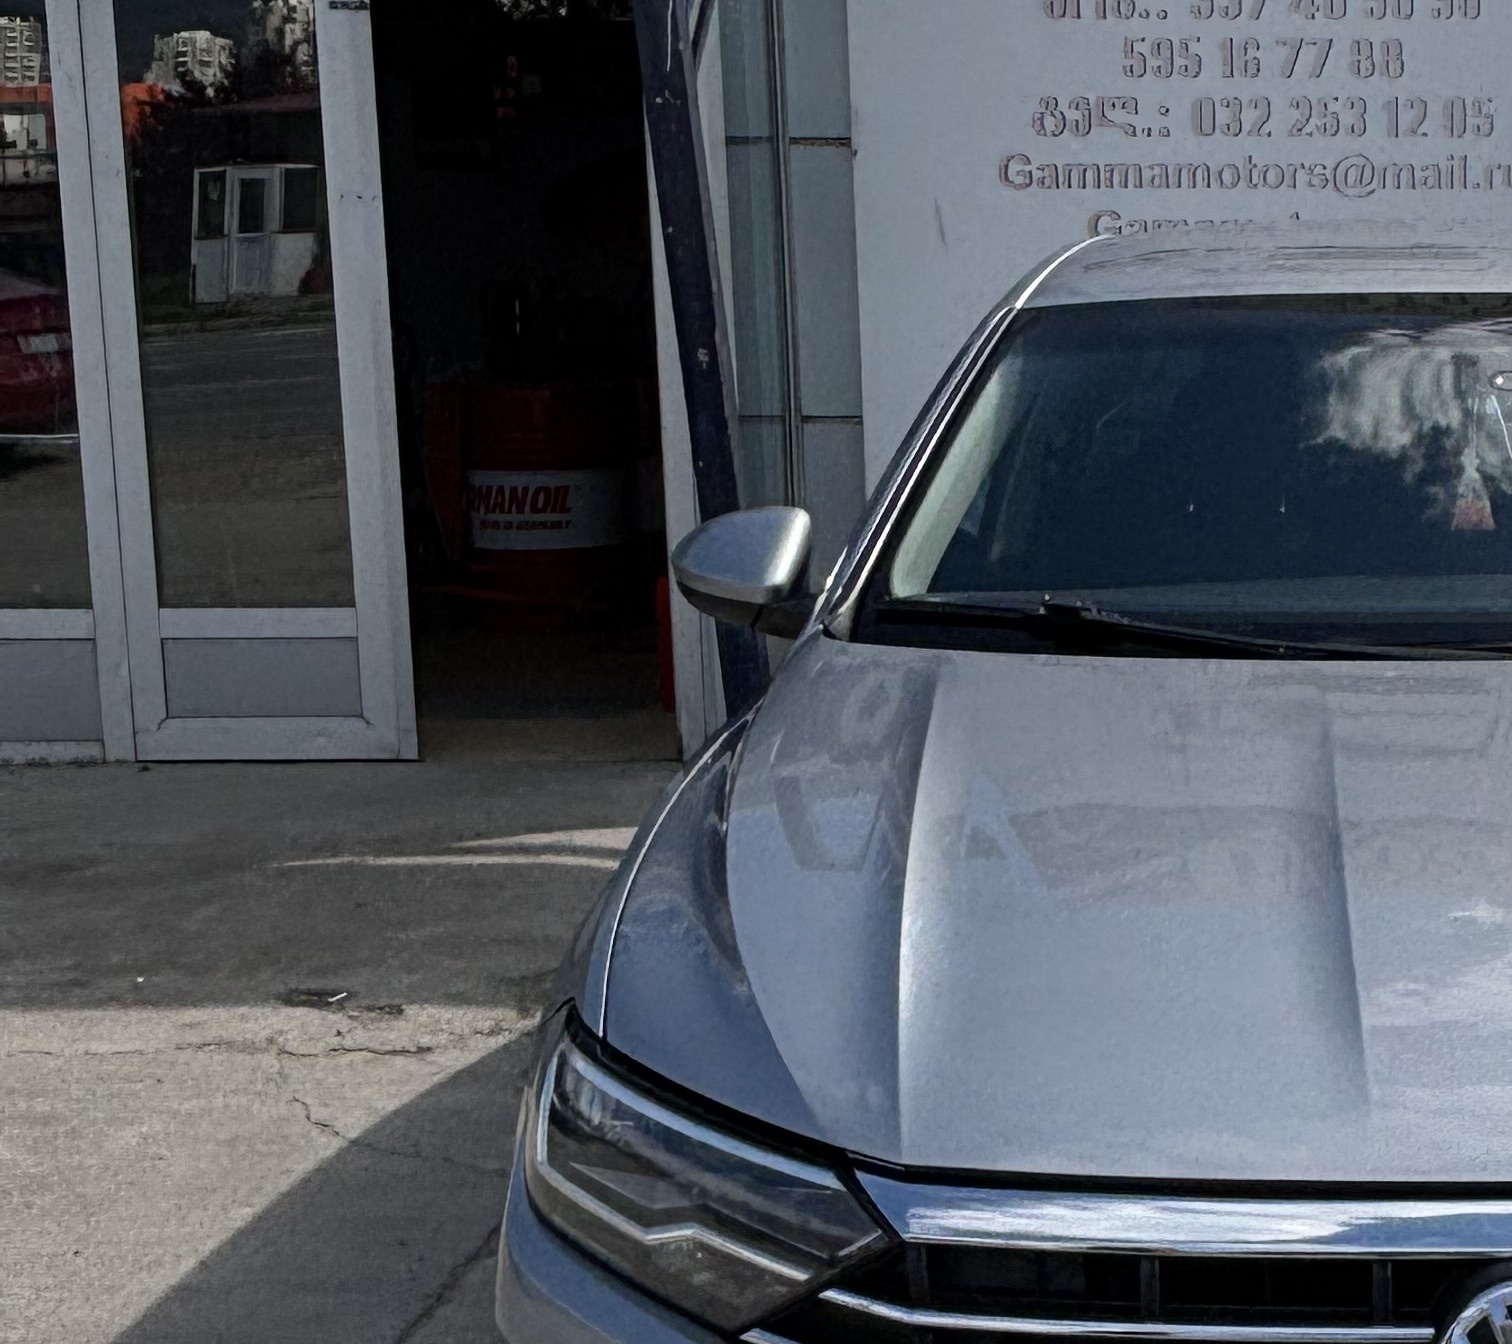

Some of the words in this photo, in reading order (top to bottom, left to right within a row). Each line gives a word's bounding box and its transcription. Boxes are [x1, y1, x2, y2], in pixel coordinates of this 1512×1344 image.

[1121, 35, 1203, 79] 595
[1274, 37, 1335, 80] 77
[1349, 37, 1405, 79] 88
[1191, 95, 1272, 138] 032
[1382, 95, 1429, 139] 12
